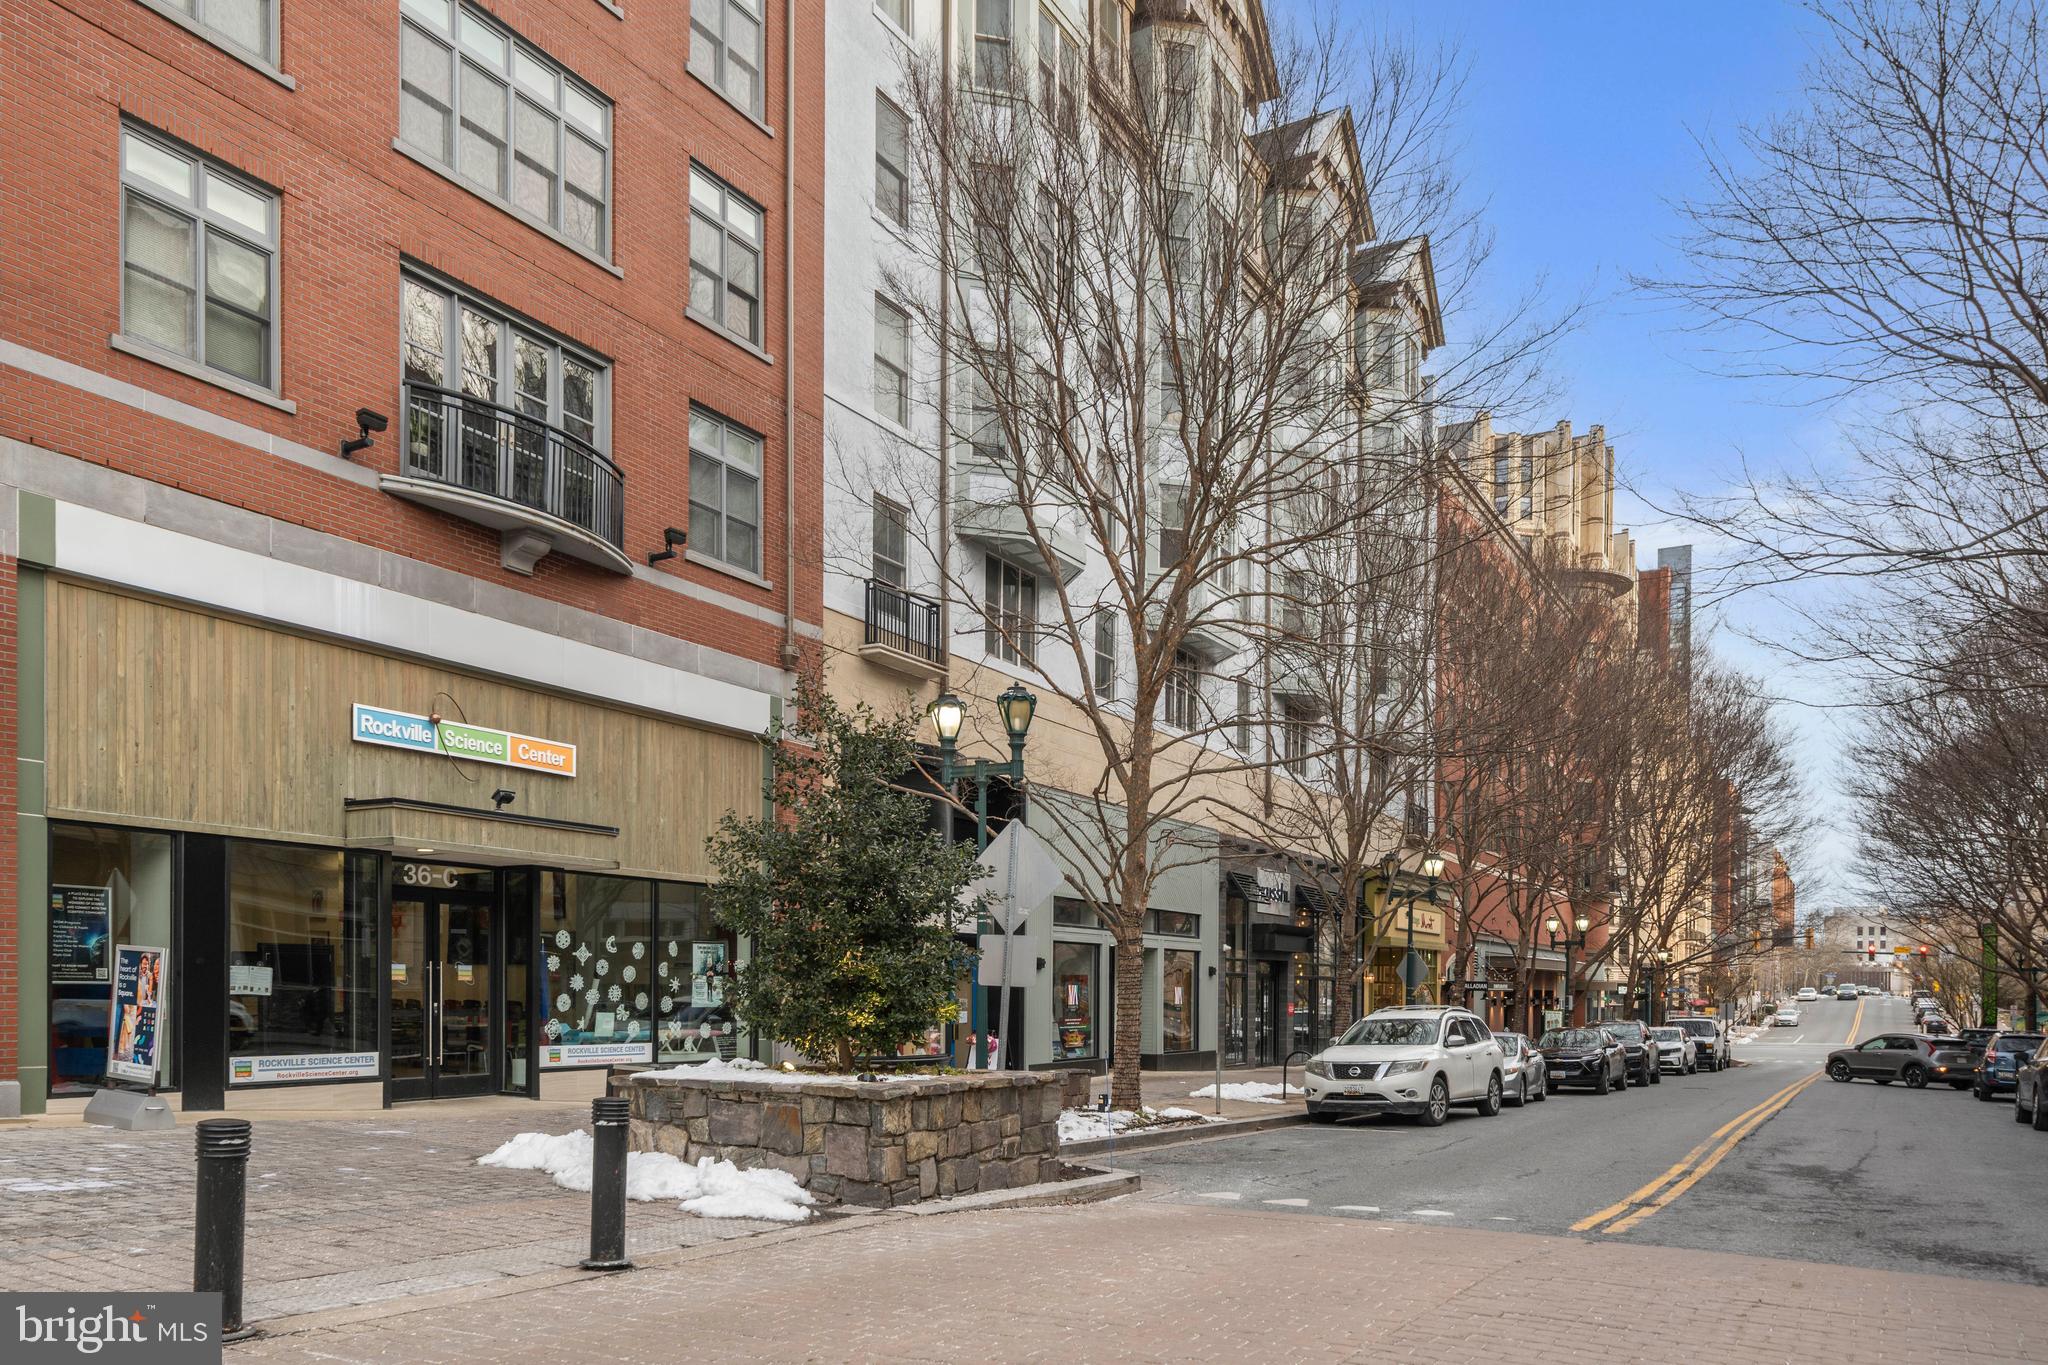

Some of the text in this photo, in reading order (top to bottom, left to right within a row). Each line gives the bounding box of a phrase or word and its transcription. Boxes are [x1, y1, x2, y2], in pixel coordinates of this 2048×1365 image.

[360, 714, 566, 767] Rockville Science Center
[403, 863, 458, 889] 36-C
[120, 957, 129, 965] The
[119, 973, 137, 981] Rockville
[567, 1045, 646, 1055] ROCKVILLE SCIENCE CENTER
[258, 1055, 376, 1068] ROCKVILLE SCIENCE CENTER
[276, 1069, 359, 1079] RockvilleScienceCenter.org
